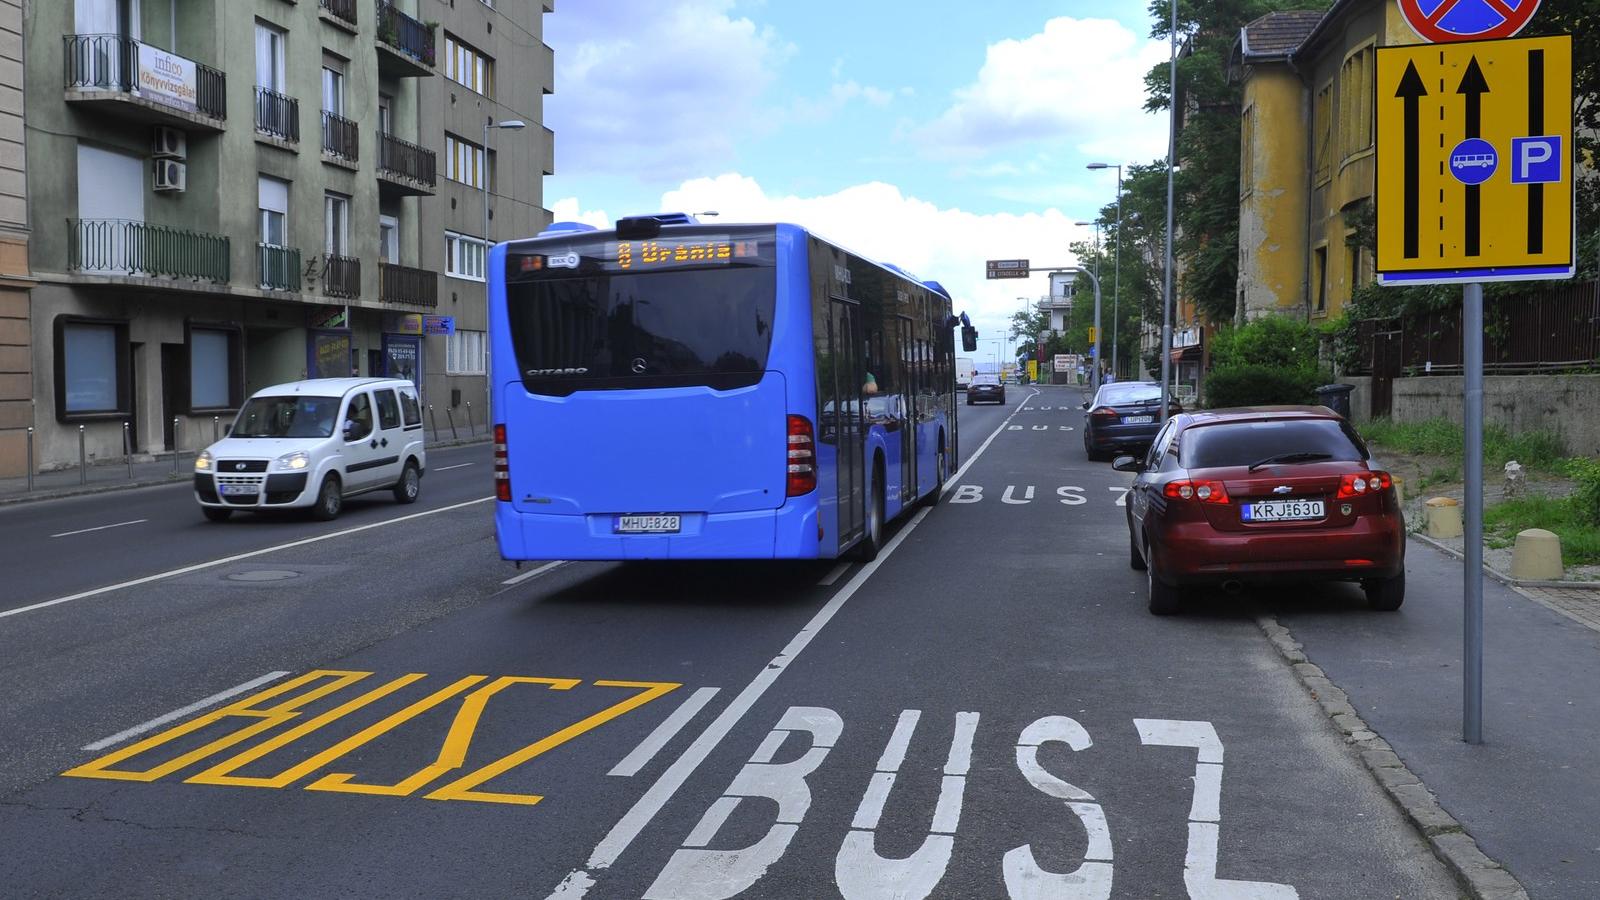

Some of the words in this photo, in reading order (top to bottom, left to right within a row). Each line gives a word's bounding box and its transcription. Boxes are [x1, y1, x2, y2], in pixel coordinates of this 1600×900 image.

[154, 51, 183, 76] infico
[1521, 141, 1552, 178] P
[527, 367, 588, 376] CITARO
[62, 670, 683, 805] BUSZ
[642, 706, 1300, 900] BUSZ
